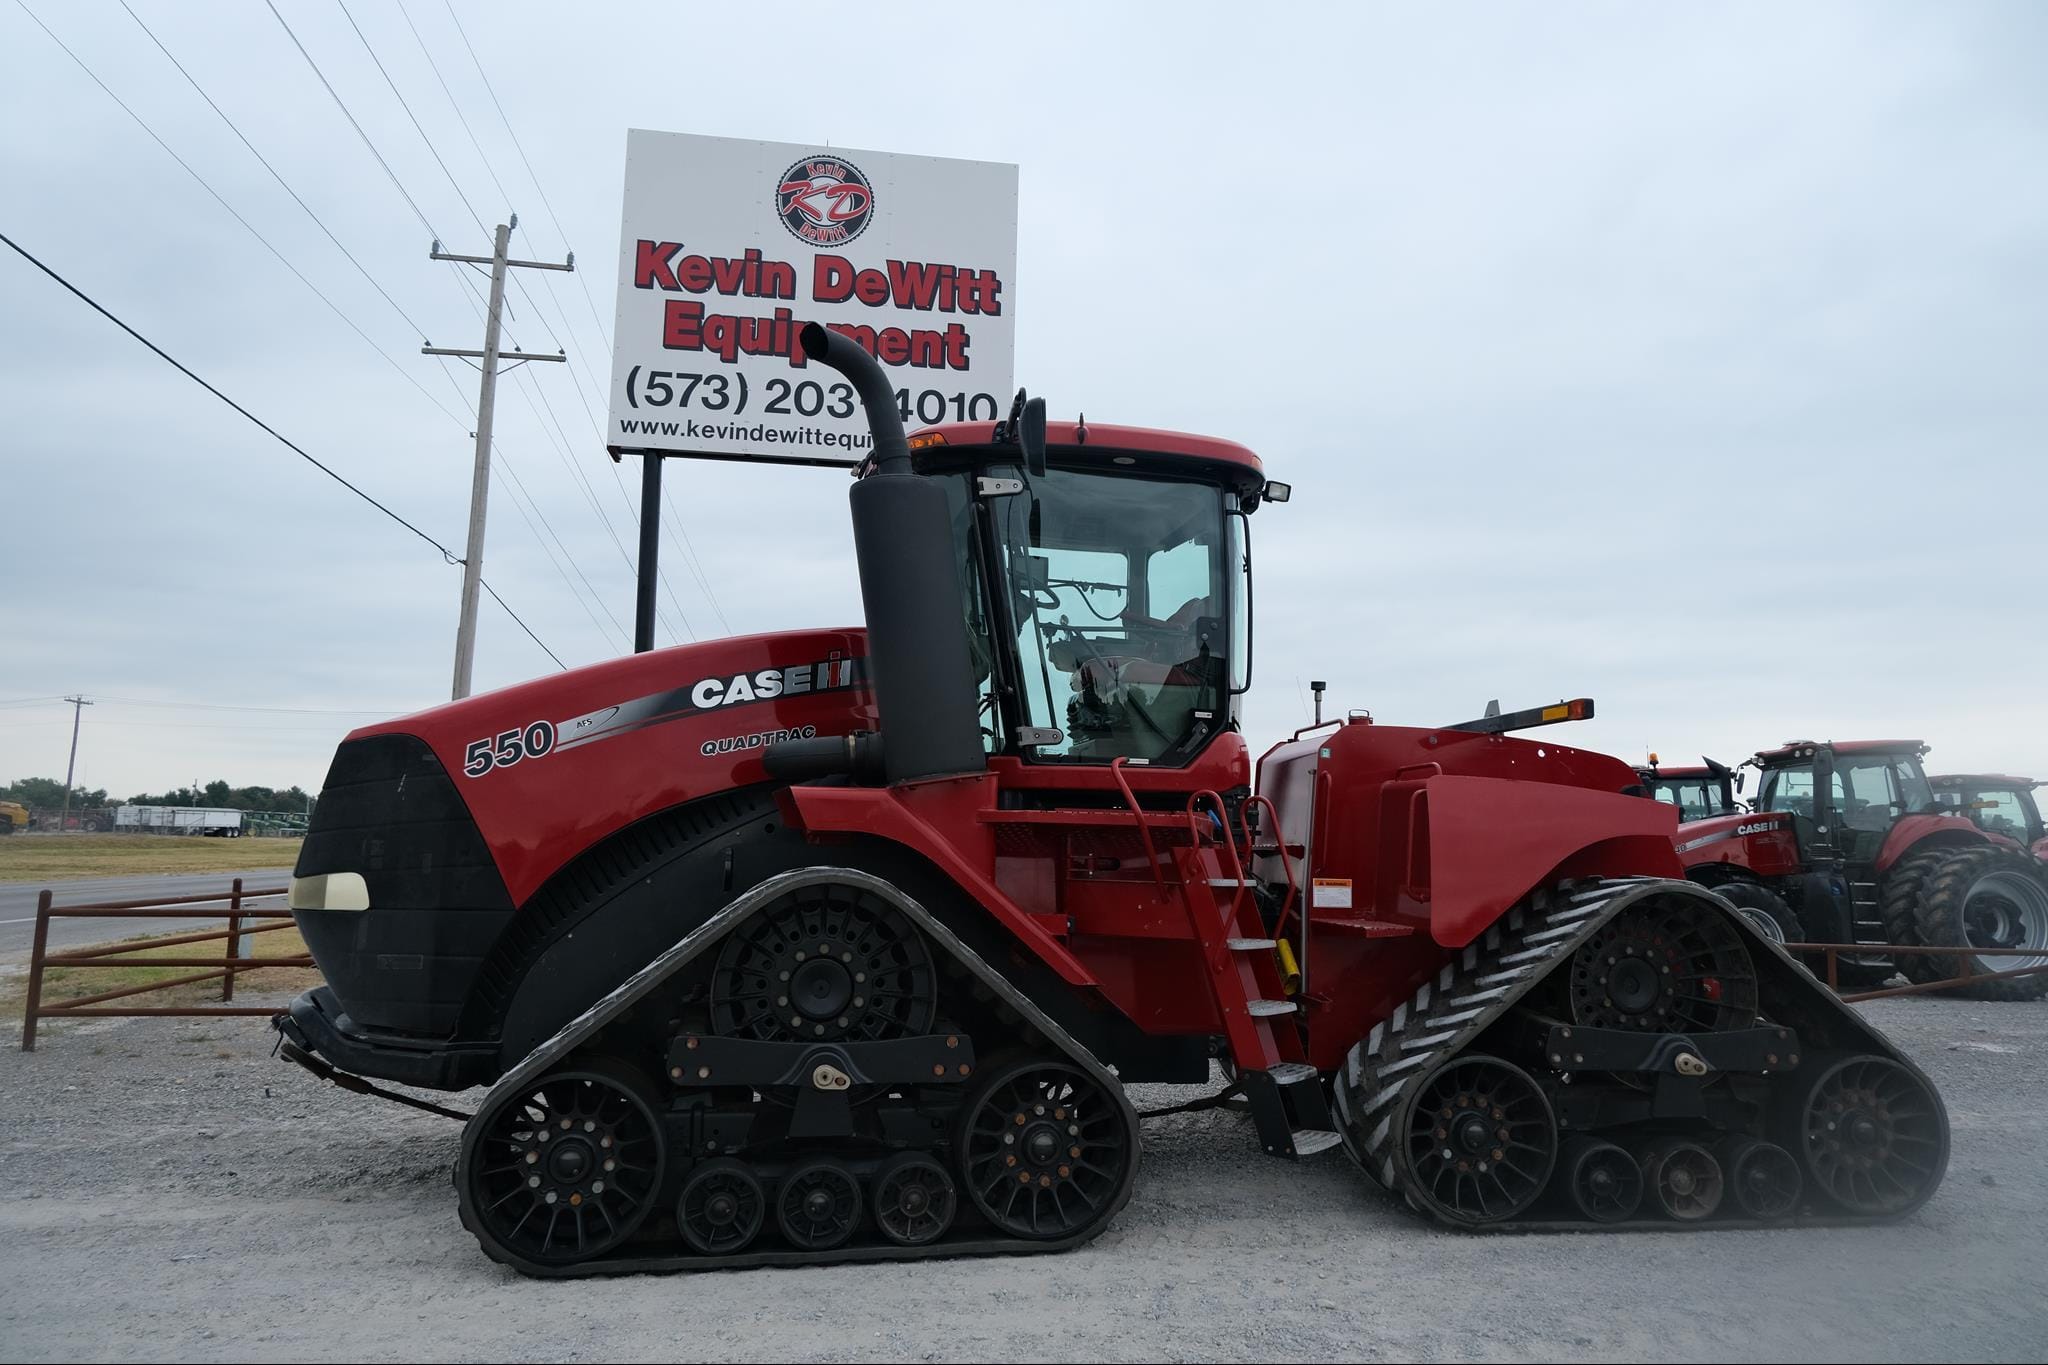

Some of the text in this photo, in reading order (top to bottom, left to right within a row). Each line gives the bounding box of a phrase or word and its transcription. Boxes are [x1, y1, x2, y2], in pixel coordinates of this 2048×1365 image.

[805, 162, 847, 180] Kevin
[799, 222, 849, 241] DeWitt
[634, 239, 1002, 317] Kevin DeWitt
[626, 365, 749, 416] (573)
[576, 718, 593, 729] AFS
[463, 720, 555, 778] 550
[700, 725, 817, 757] QUADTRAC
